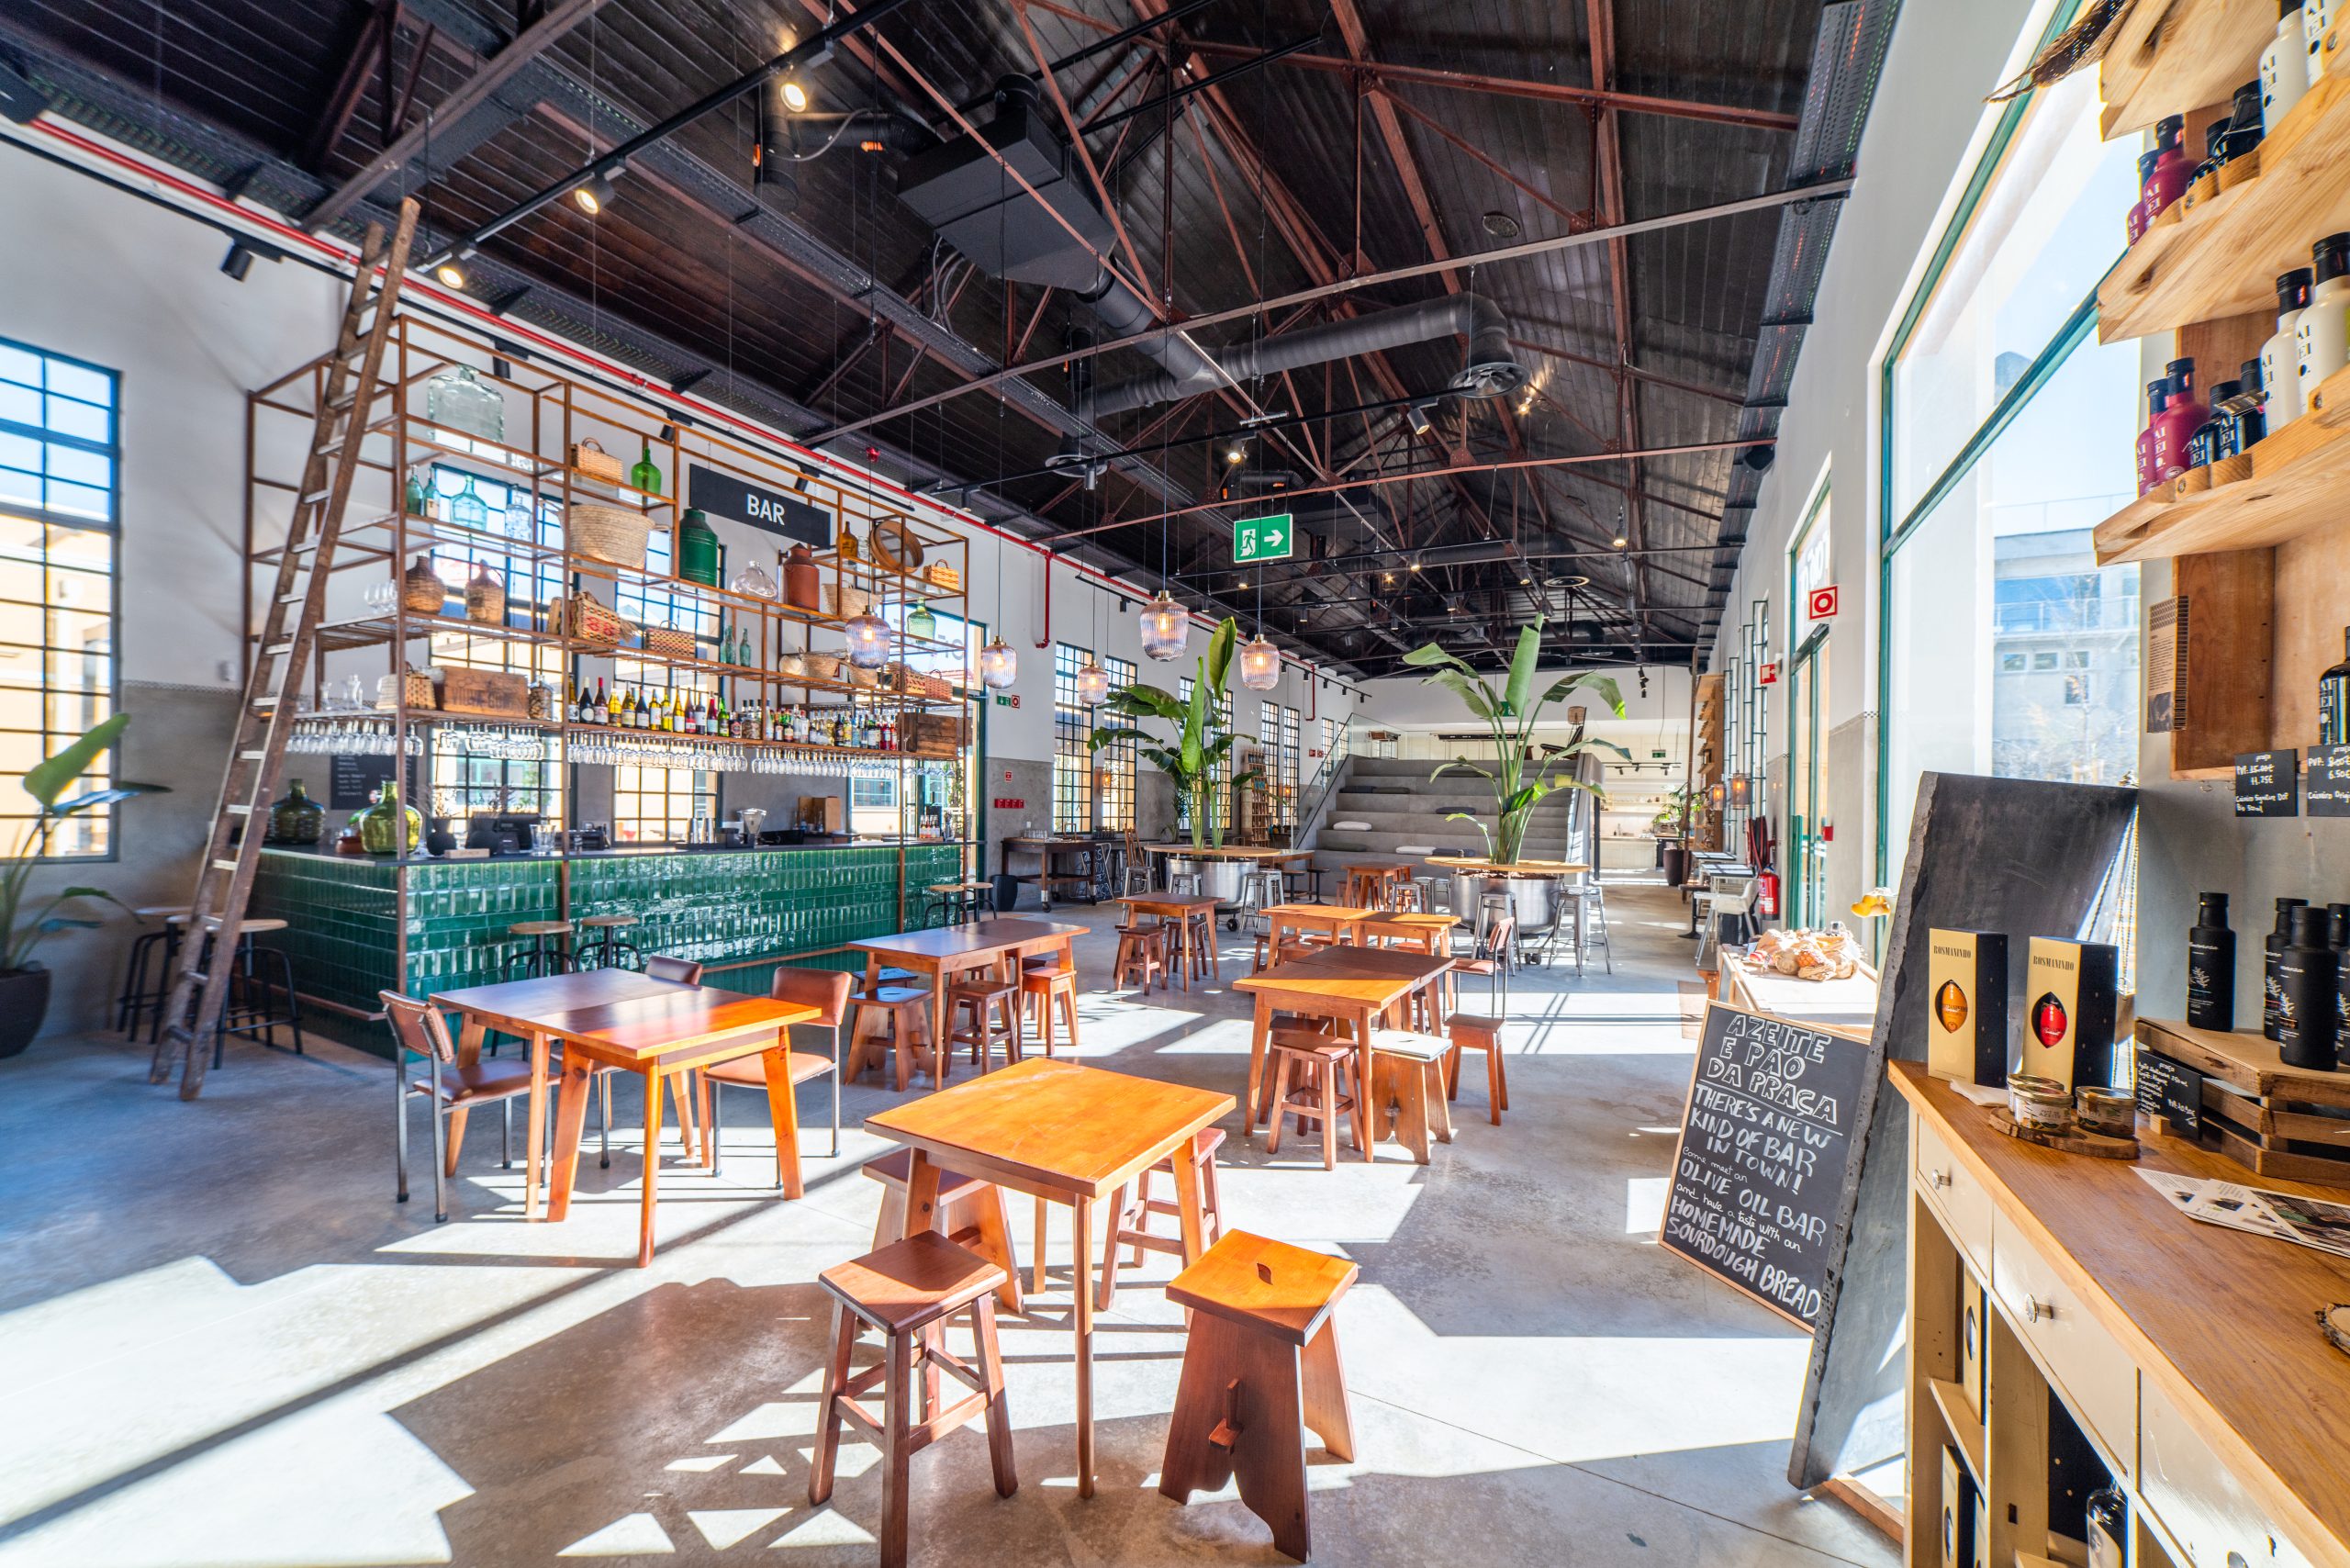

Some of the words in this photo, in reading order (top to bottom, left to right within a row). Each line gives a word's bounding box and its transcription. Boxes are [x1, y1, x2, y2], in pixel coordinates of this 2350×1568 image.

[747, 493, 786, 525] BAR
[1933, 945, 1972, 959] ROSMANINHO
[2032, 955, 2075, 971] ROSMANINHO
[1719, 1036, 1738, 1059] E
[1744, 1042, 1806, 1081] PÃO
[1726, 1014, 1832, 1064] AZEITE
[1695, 1083, 1762, 1123] THERE'S
[1761, 1111, 1774, 1129] A
[1776, 1116, 1832, 1148] NEW
[1706, 1057, 1742, 1088] DA
[1748, 1070, 1838, 1126] PRAÇA
[1689, 1106, 1734, 1139] KIND
[1736, 1127, 1764, 1150] OF
[1762, 1137, 1818, 1178] BAR
[1707, 1137, 1731, 1154] IN
[1734, 1148, 1804, 1195] TOWN!
[1711, 1160, 1734, 1176] meet
[1734, 1171, 1749, 1183] an
[1670, 1194, 1771, 1260] HOMEMADE
[1676, 1183, 1699, 1200] and
[1702, 1193, 1724, 1213] have
[1727, 1210, 1736, 1218] a
[1737, 1209, 1757, 1228] taste
[1759, 1224, 1781, 1242] with
[1784, 1239, 1802, 1253] an
[1680, 1158, 1733, 1195] OLIVE
[1739, 1188, 1772, 1217] OIL
[1776, 1204, 1828, 1247] BAR
[1666, 1216, 1760, 1282] SOURDOUGH
[1759, 1264, 1822, 1318] BREAD
